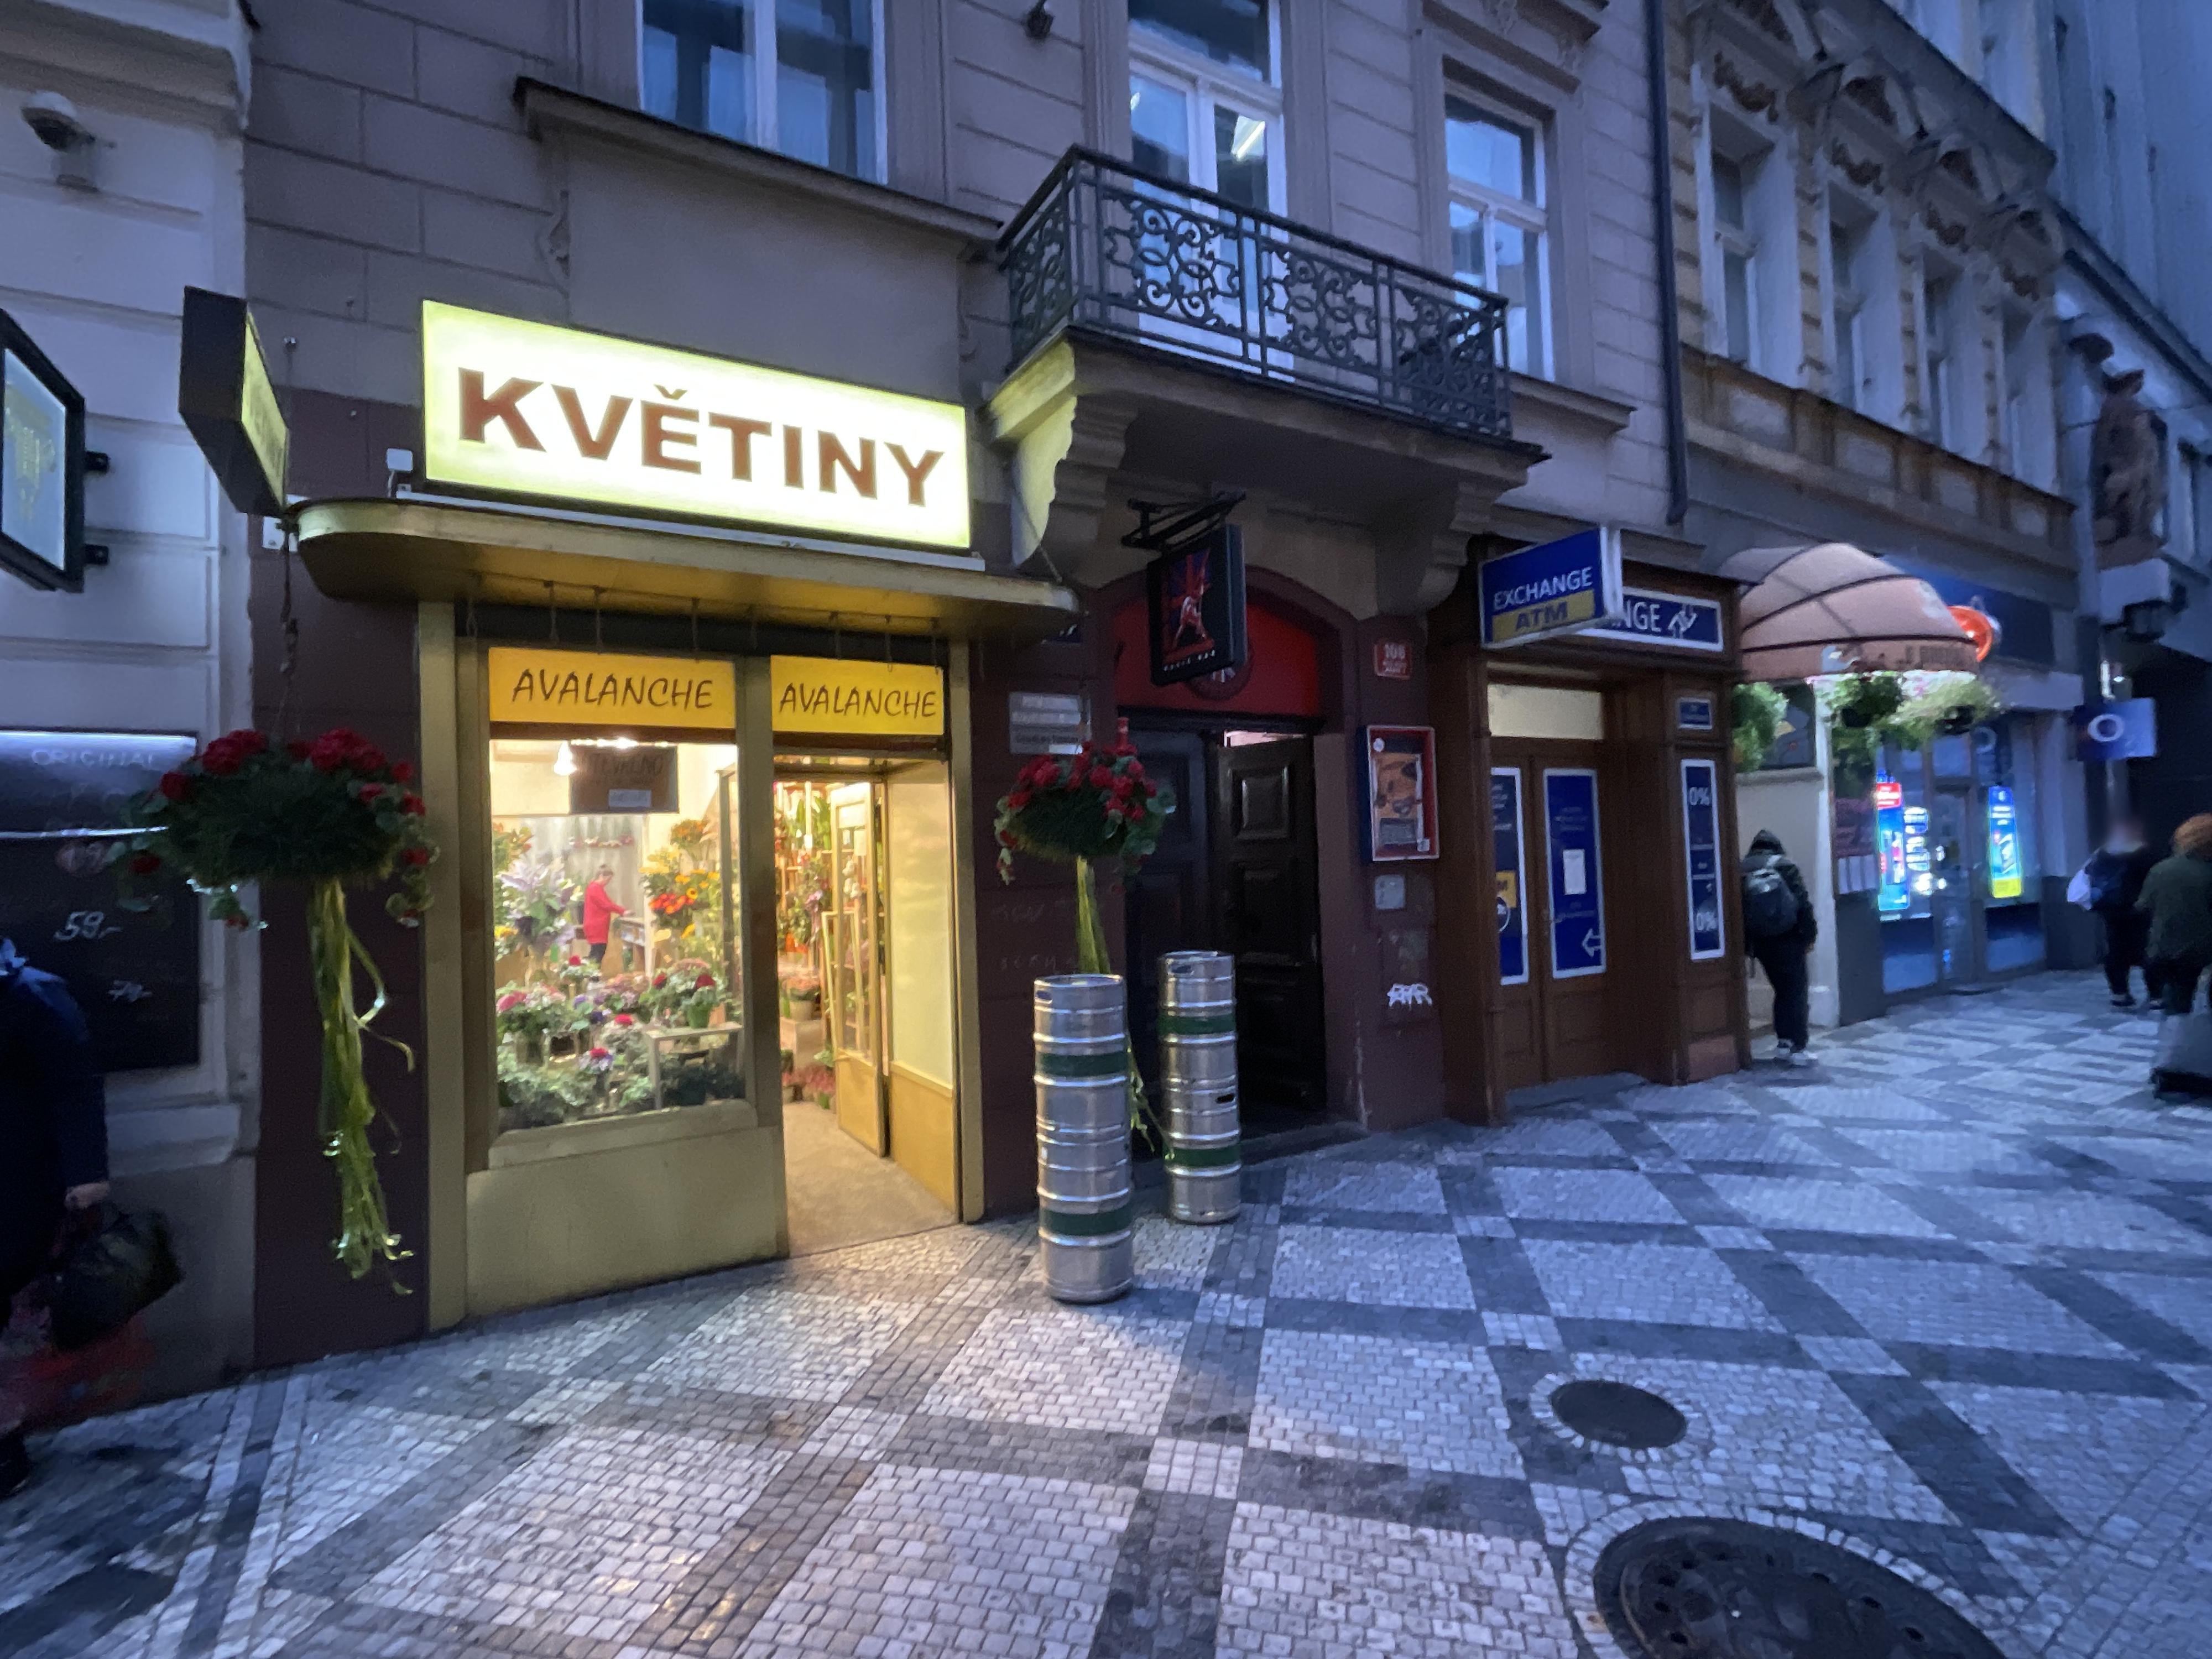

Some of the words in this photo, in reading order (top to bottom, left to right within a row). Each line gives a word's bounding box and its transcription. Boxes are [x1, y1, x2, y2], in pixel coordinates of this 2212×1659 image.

[458, 367, 945, 508] KVĚTINY
[1494, 566, 1593, 609] EXCHANGE
[1515, 601, 1568, 631] ATM
[511, 668, 713, 709] AVALANCHE
[779, 682, 937, 719] AVALANCHE
